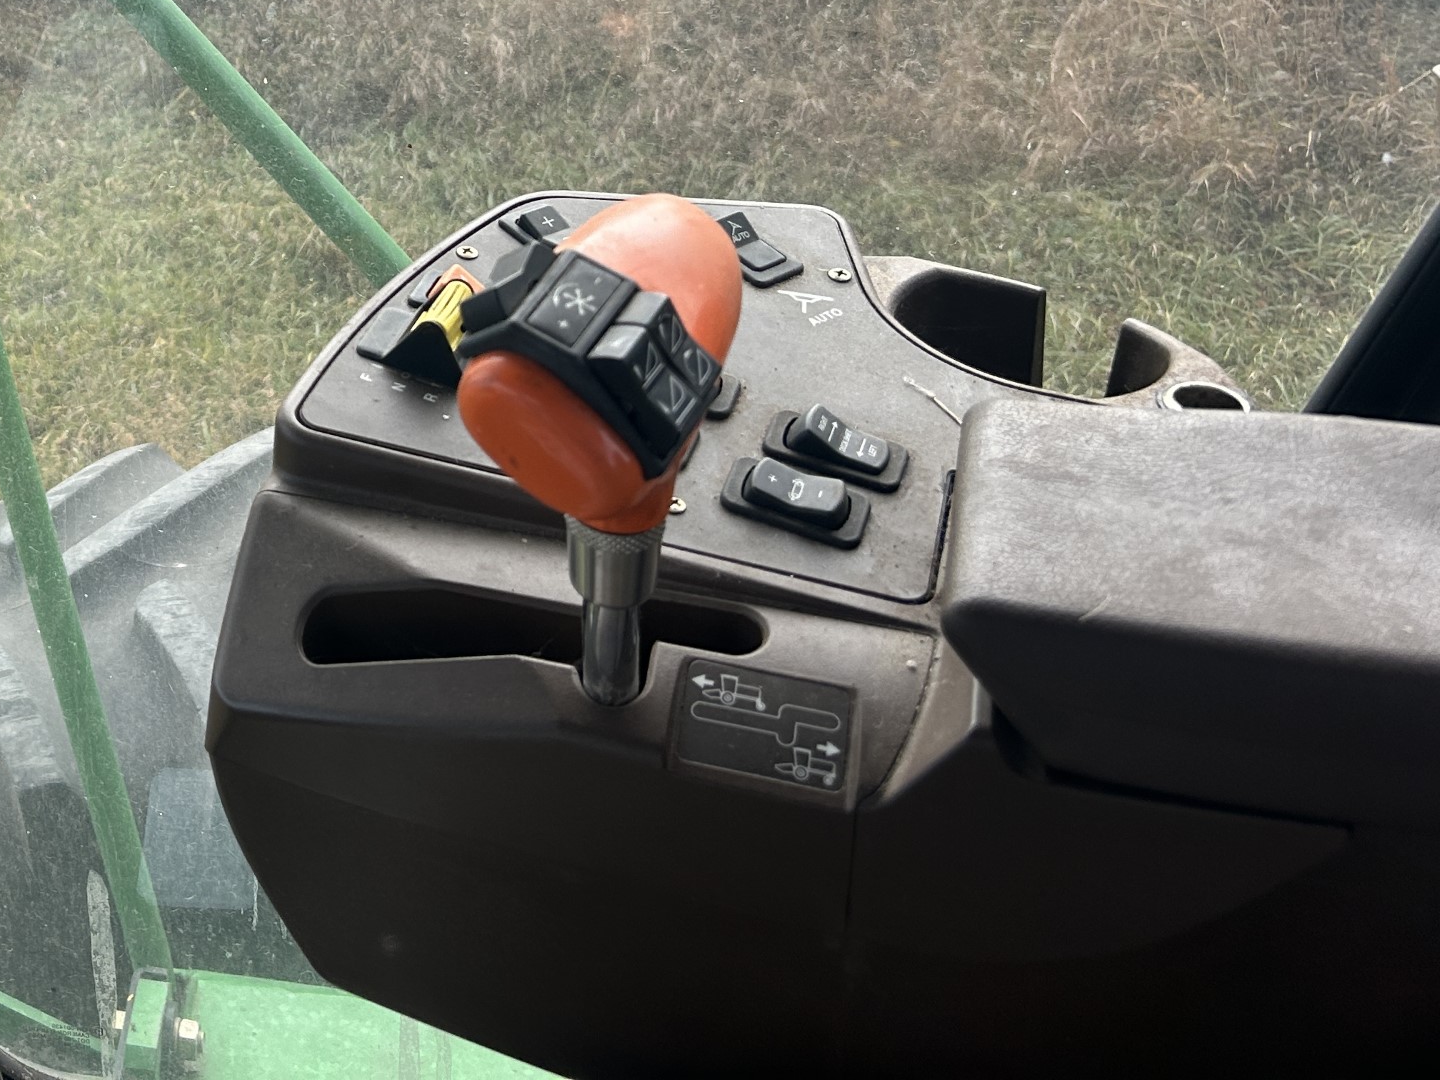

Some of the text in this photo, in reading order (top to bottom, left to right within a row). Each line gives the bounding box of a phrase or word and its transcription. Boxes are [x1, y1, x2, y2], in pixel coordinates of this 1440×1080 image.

[732, 230, 751, 243] AUTO
[808, 307, 844, 327] AUTO
[360, 372, 372, 382] F
[391, 381, 407, 392] N
[423, 392, 438, 403] R
[867, 444, 878, 458] LEFT
